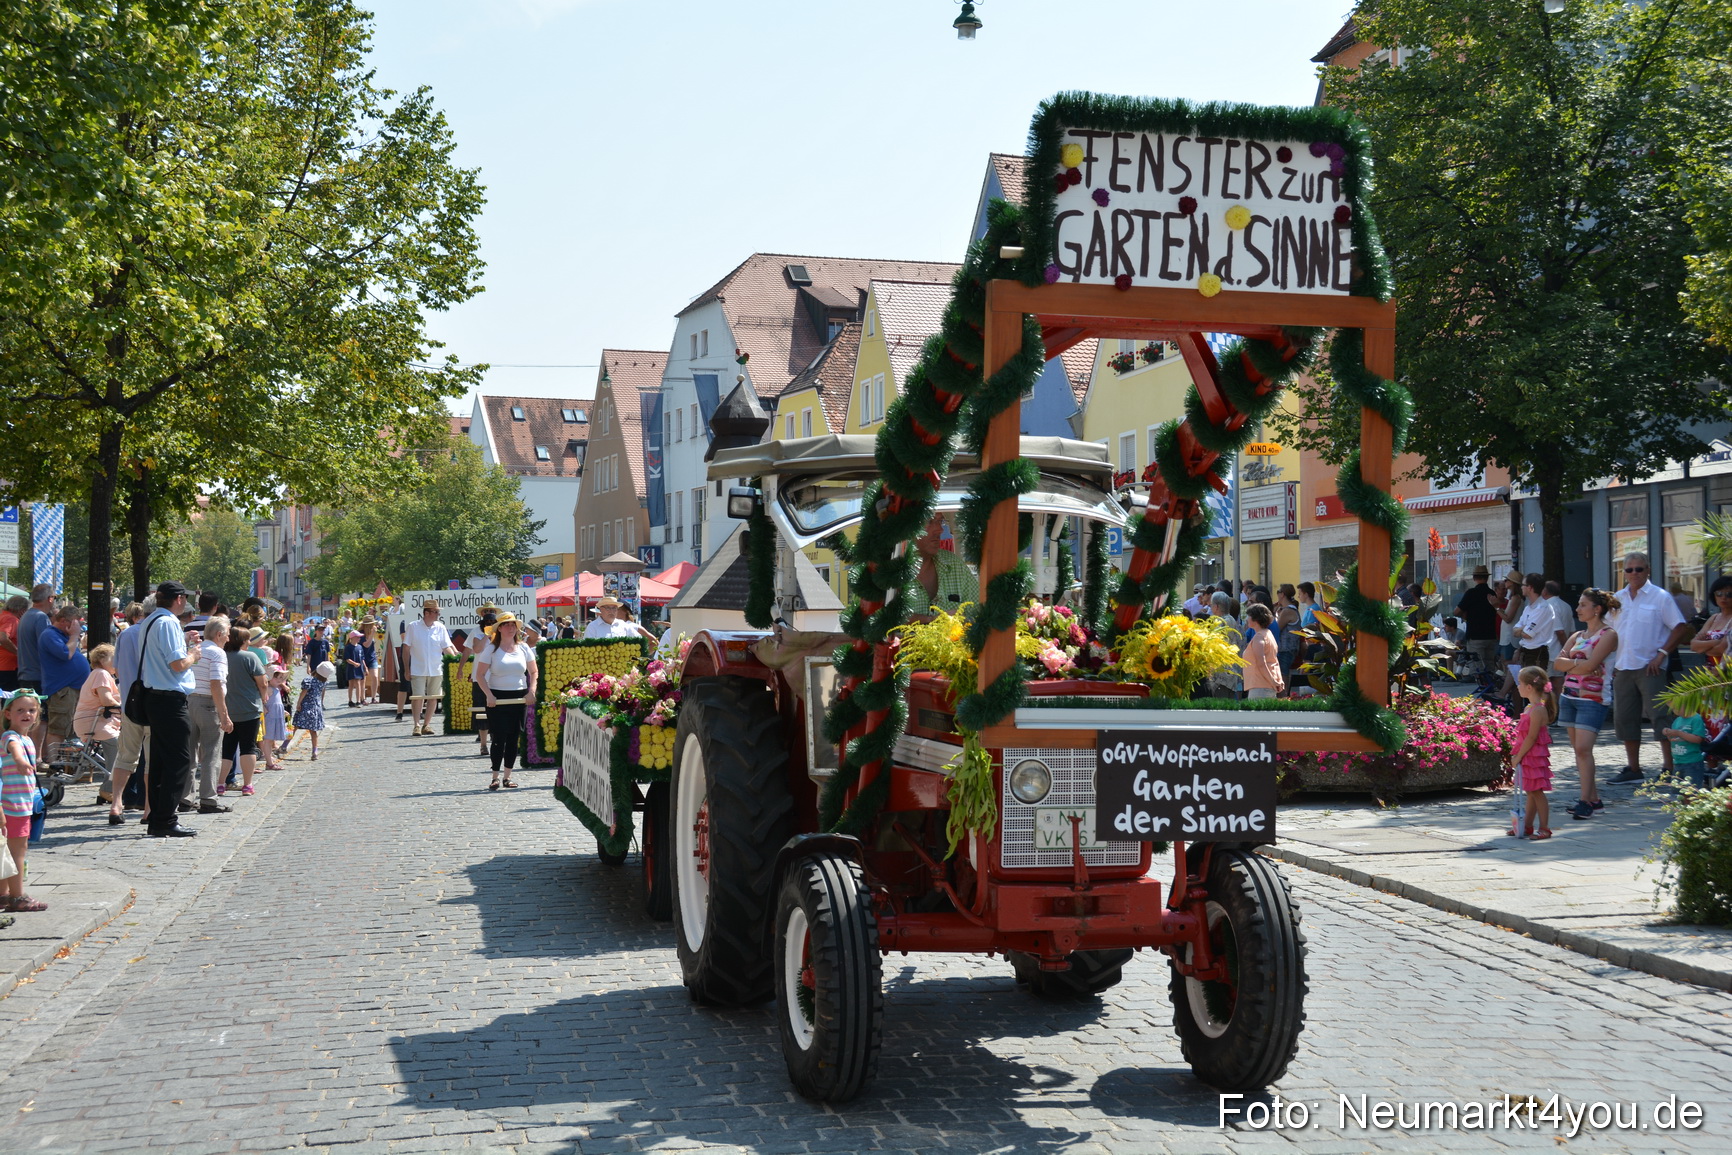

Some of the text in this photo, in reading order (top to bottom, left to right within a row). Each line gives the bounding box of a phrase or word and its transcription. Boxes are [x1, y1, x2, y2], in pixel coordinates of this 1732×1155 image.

[1067, 130, 1273, 199] FENSTER
[1053, 208, 1209, 283] GARTEN
[1244, 214, 1350, 291] SINNE
[1250, 445, 1266, 454] KINO
[1248, 505, 1278, 519] RIALTO KINO
[1287, 484, 1295, 535] KINO
[411, 594, 425, 608] 50
[506, 591, 529, 606] Kirch
[1133, 769, 1244, 802] Garten
[1114, 804, 1266, 834] der Sinne
[1043, 830, 1066, 846] VK
